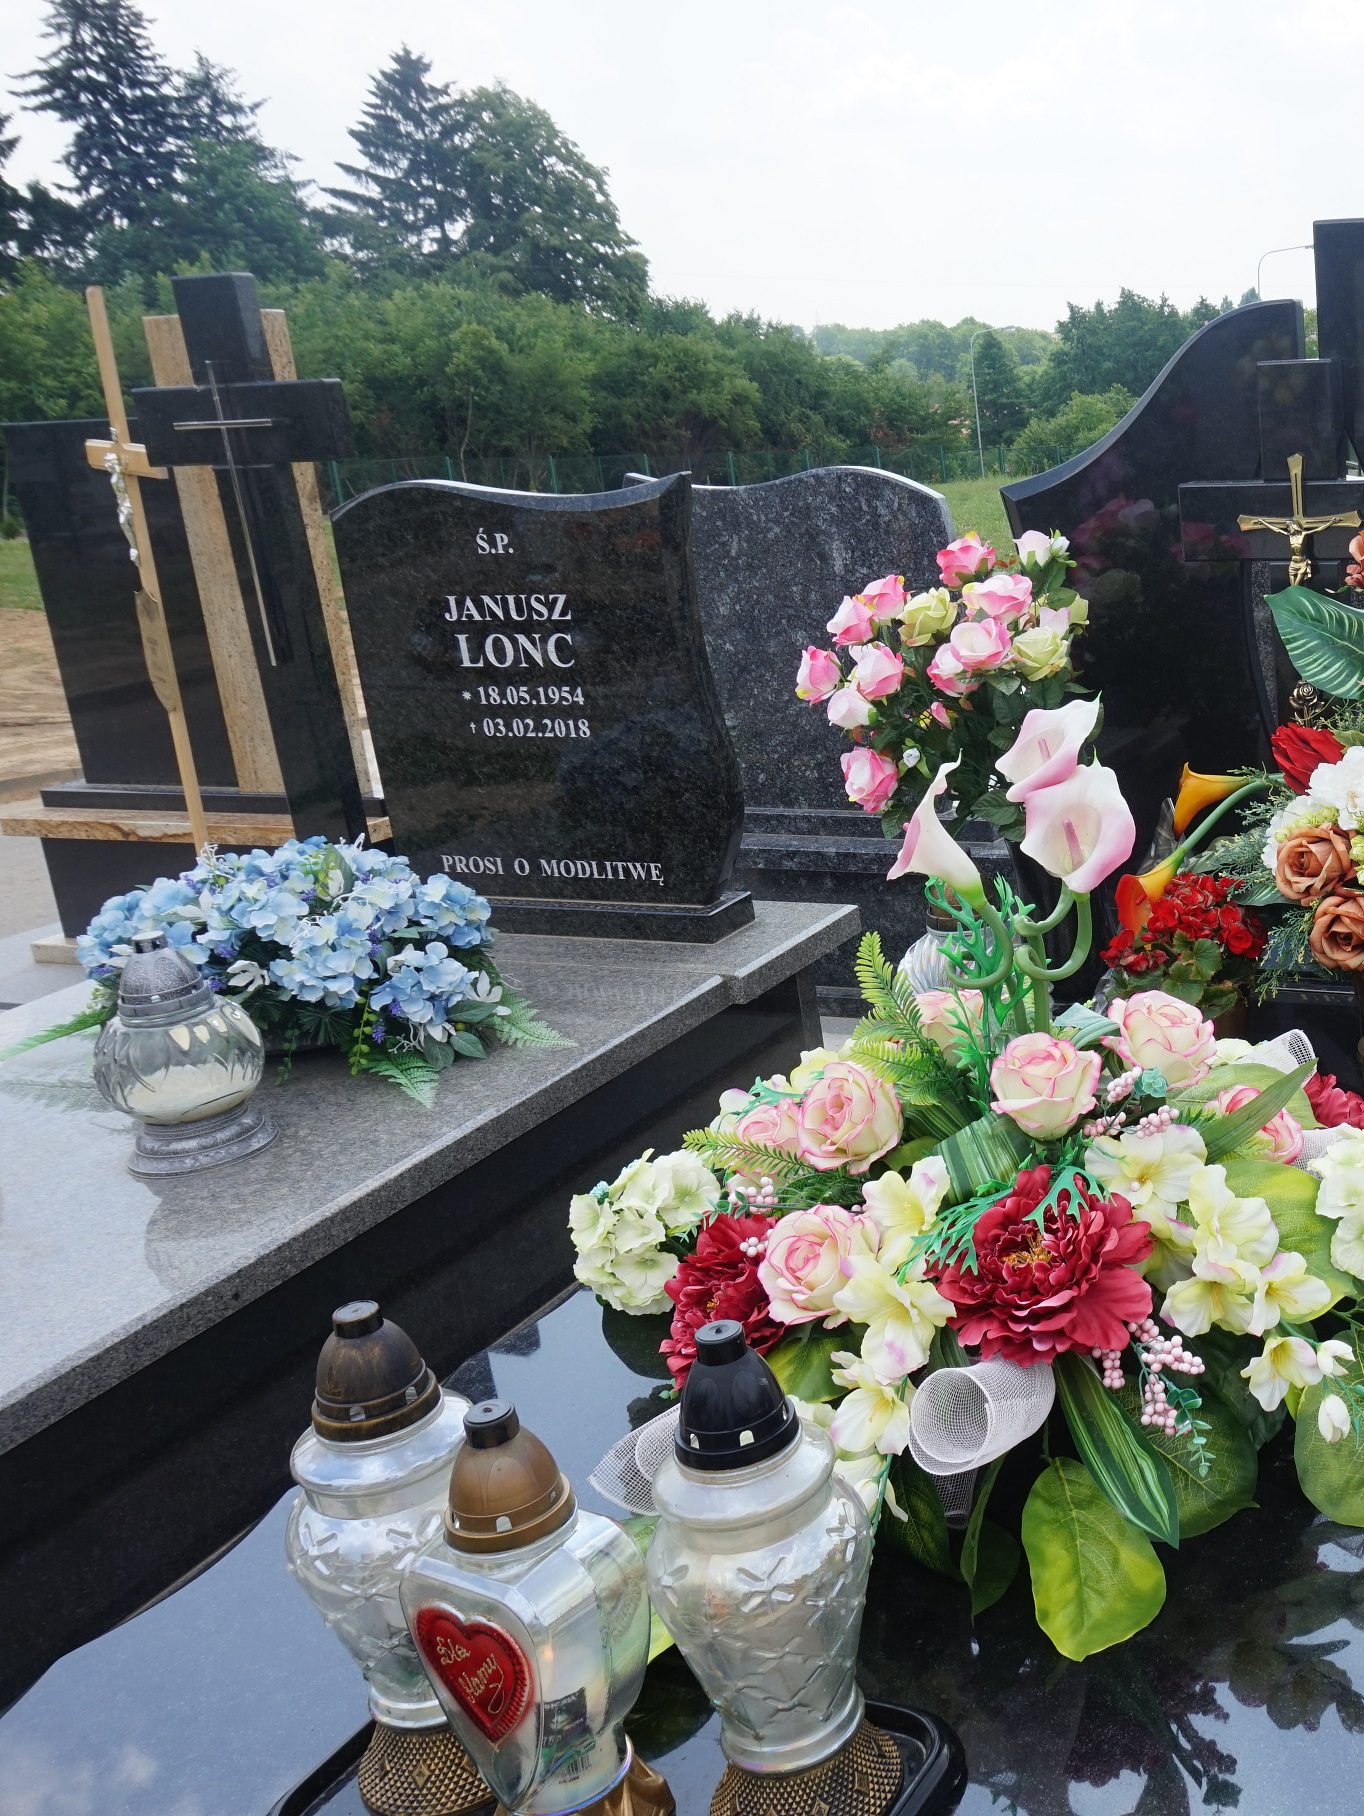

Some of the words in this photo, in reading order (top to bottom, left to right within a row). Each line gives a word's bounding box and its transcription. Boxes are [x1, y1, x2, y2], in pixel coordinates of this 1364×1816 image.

[476, 528, 513, 554] Ś.P.
[445, 594, 571, 621] JANUSZ
[455, 633, 574, 667] LONC
[478, 686, 584, 705] 18.05.1954
[483, 718, 590, 737] 03.02.2018
[441, 855, 504, 875] PROSI
[514, 858, 530, 875] O
[540, 860, 664, 885] MODLITWĘ
